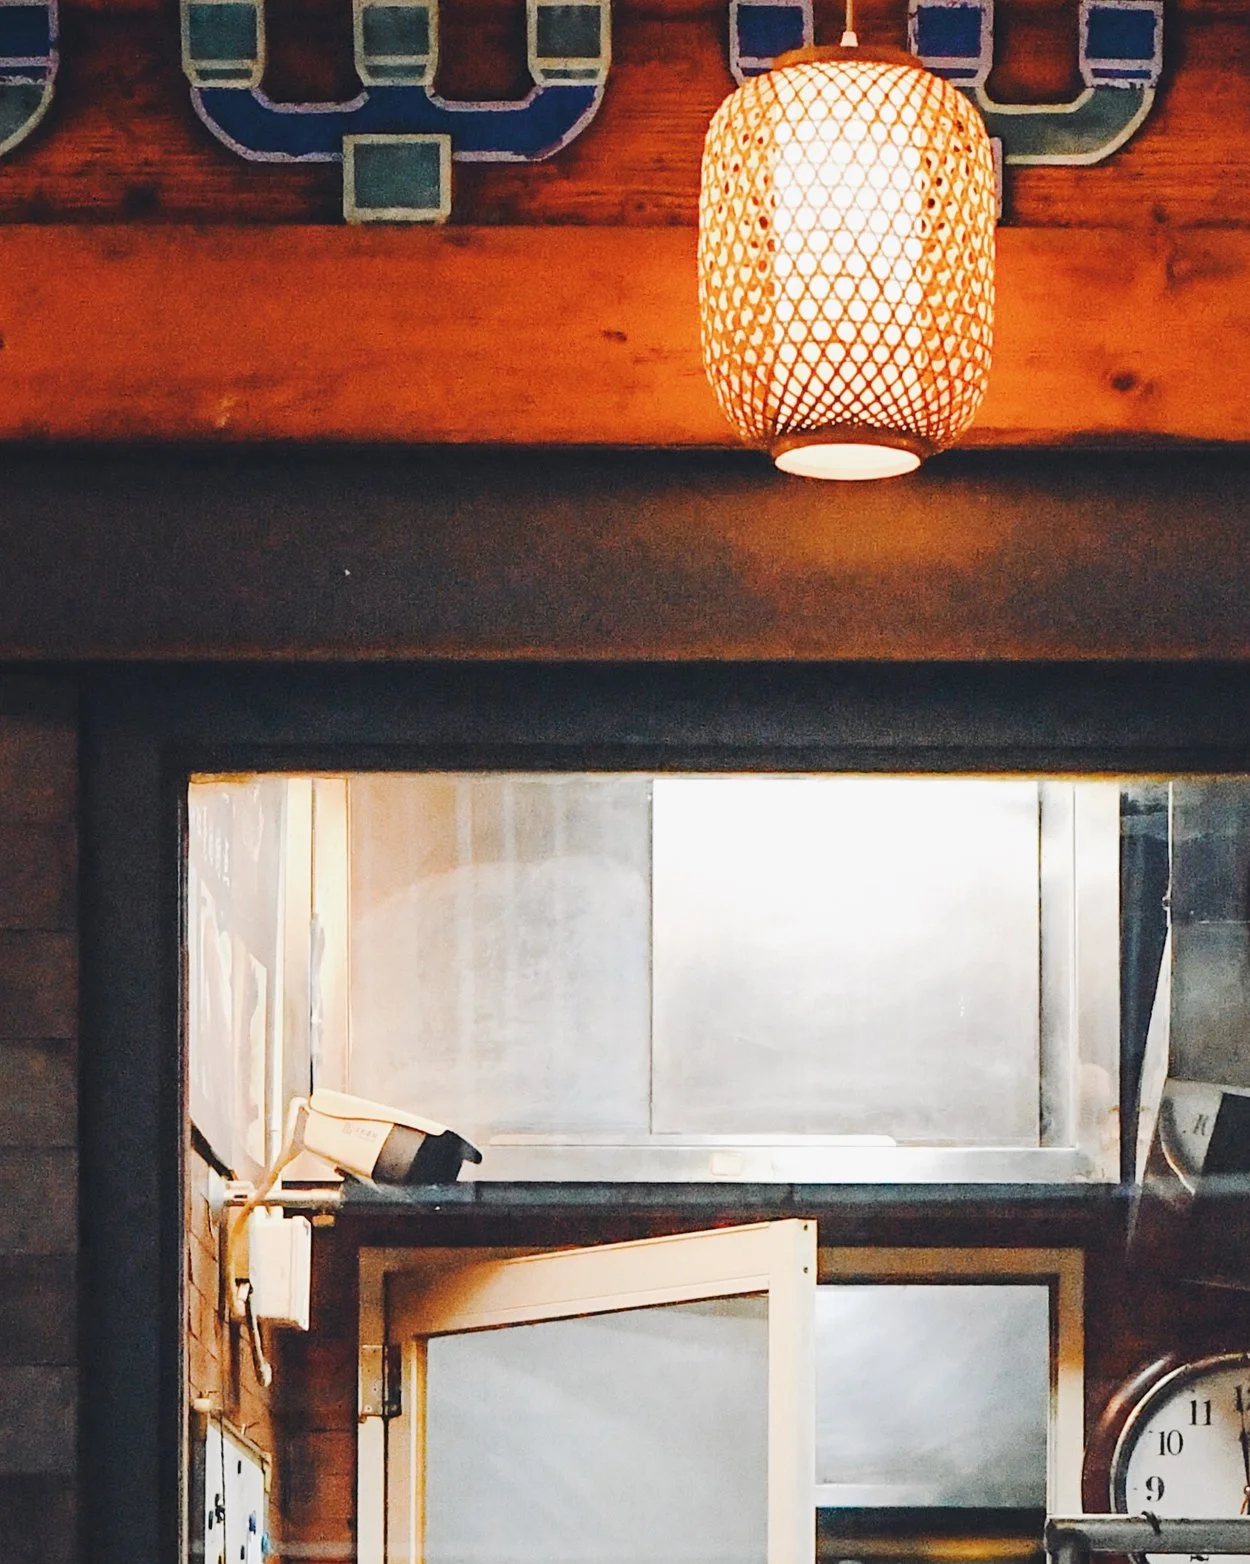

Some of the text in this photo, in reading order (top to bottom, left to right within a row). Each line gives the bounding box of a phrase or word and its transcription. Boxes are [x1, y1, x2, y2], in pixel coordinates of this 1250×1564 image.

[1189, 1400, 1212, 1426] 11
[1159, 1430, 1184, 1456] 10
[1145, 1475, 1165, 1503] 9
